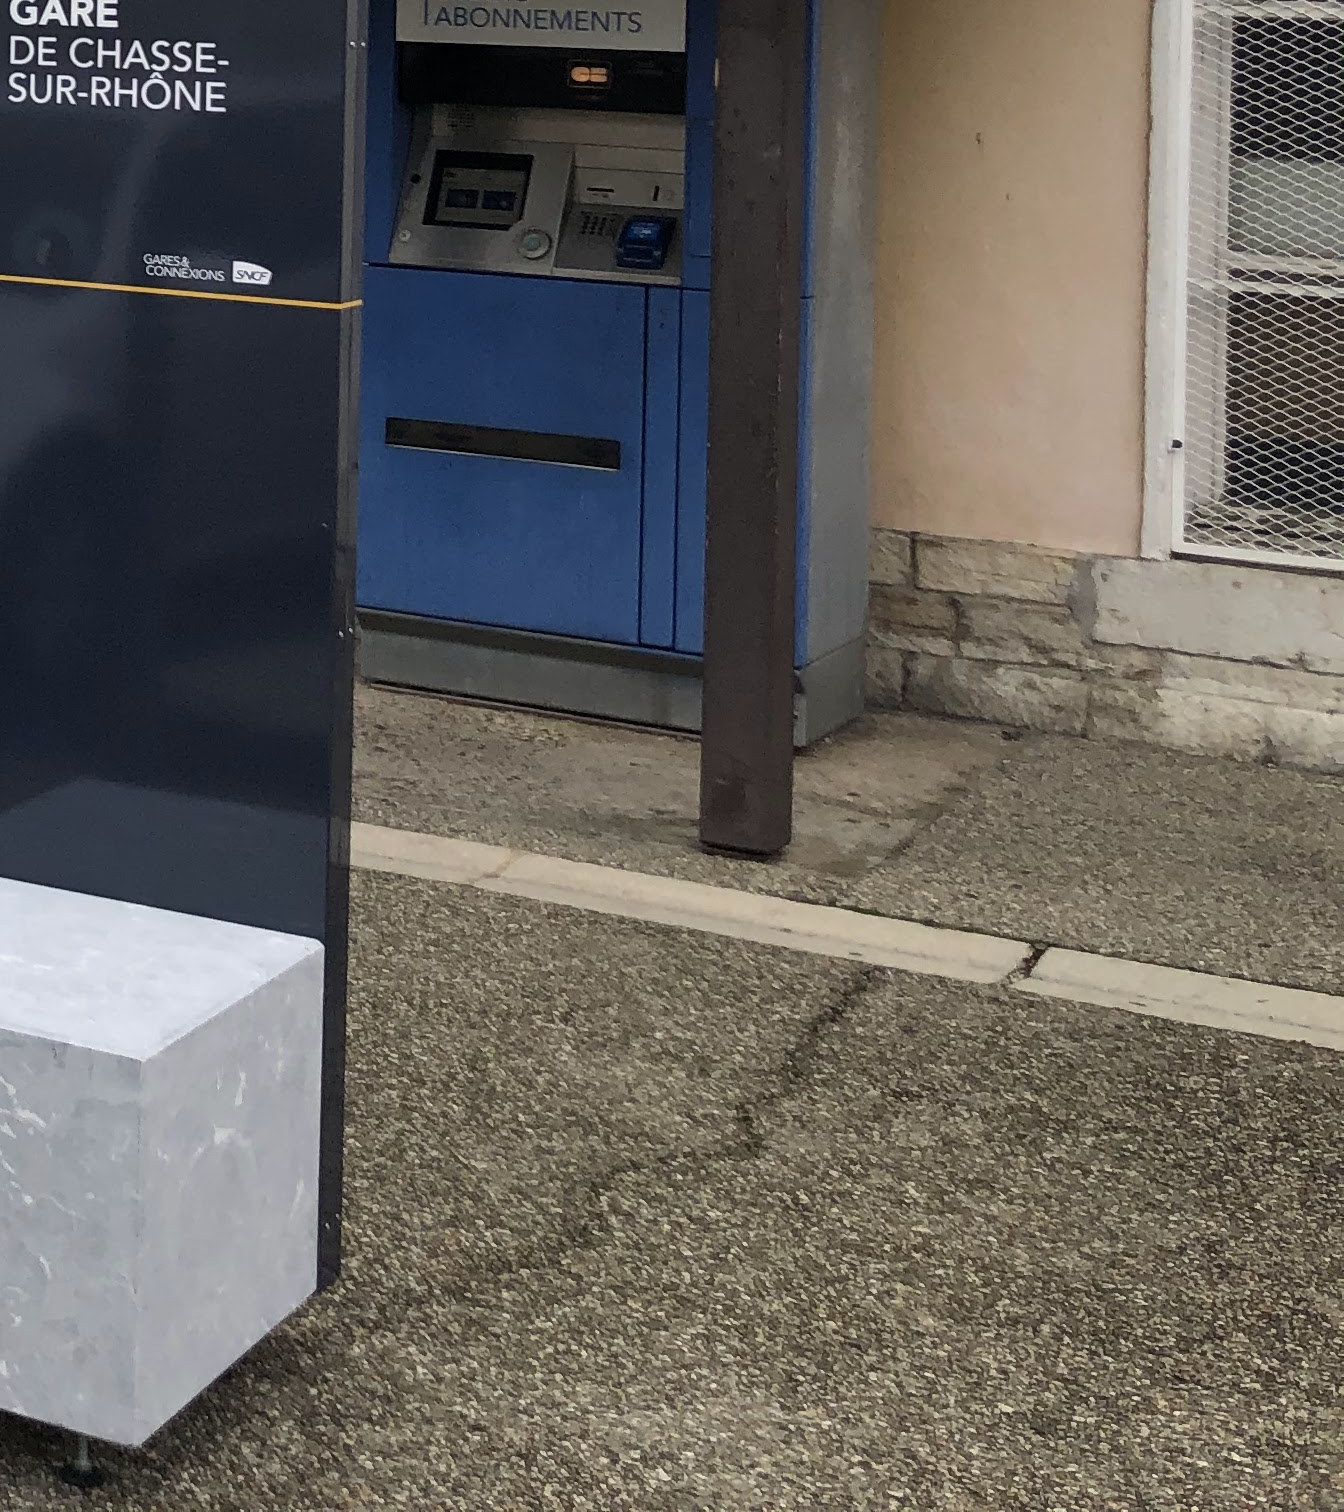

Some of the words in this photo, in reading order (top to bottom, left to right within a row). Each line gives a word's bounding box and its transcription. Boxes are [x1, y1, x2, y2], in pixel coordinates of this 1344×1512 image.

[434, 7, 643, 34] ABONNEMENTS
[9, 36, 57, 67] DE
[69, 38, 229, 74] CHASSE-
[8, 72, 226, 113] SUR-RHÔNE
[145, 265, 226, 282] CONNEXIONS
[235, 270, 269, 281] SNCF
